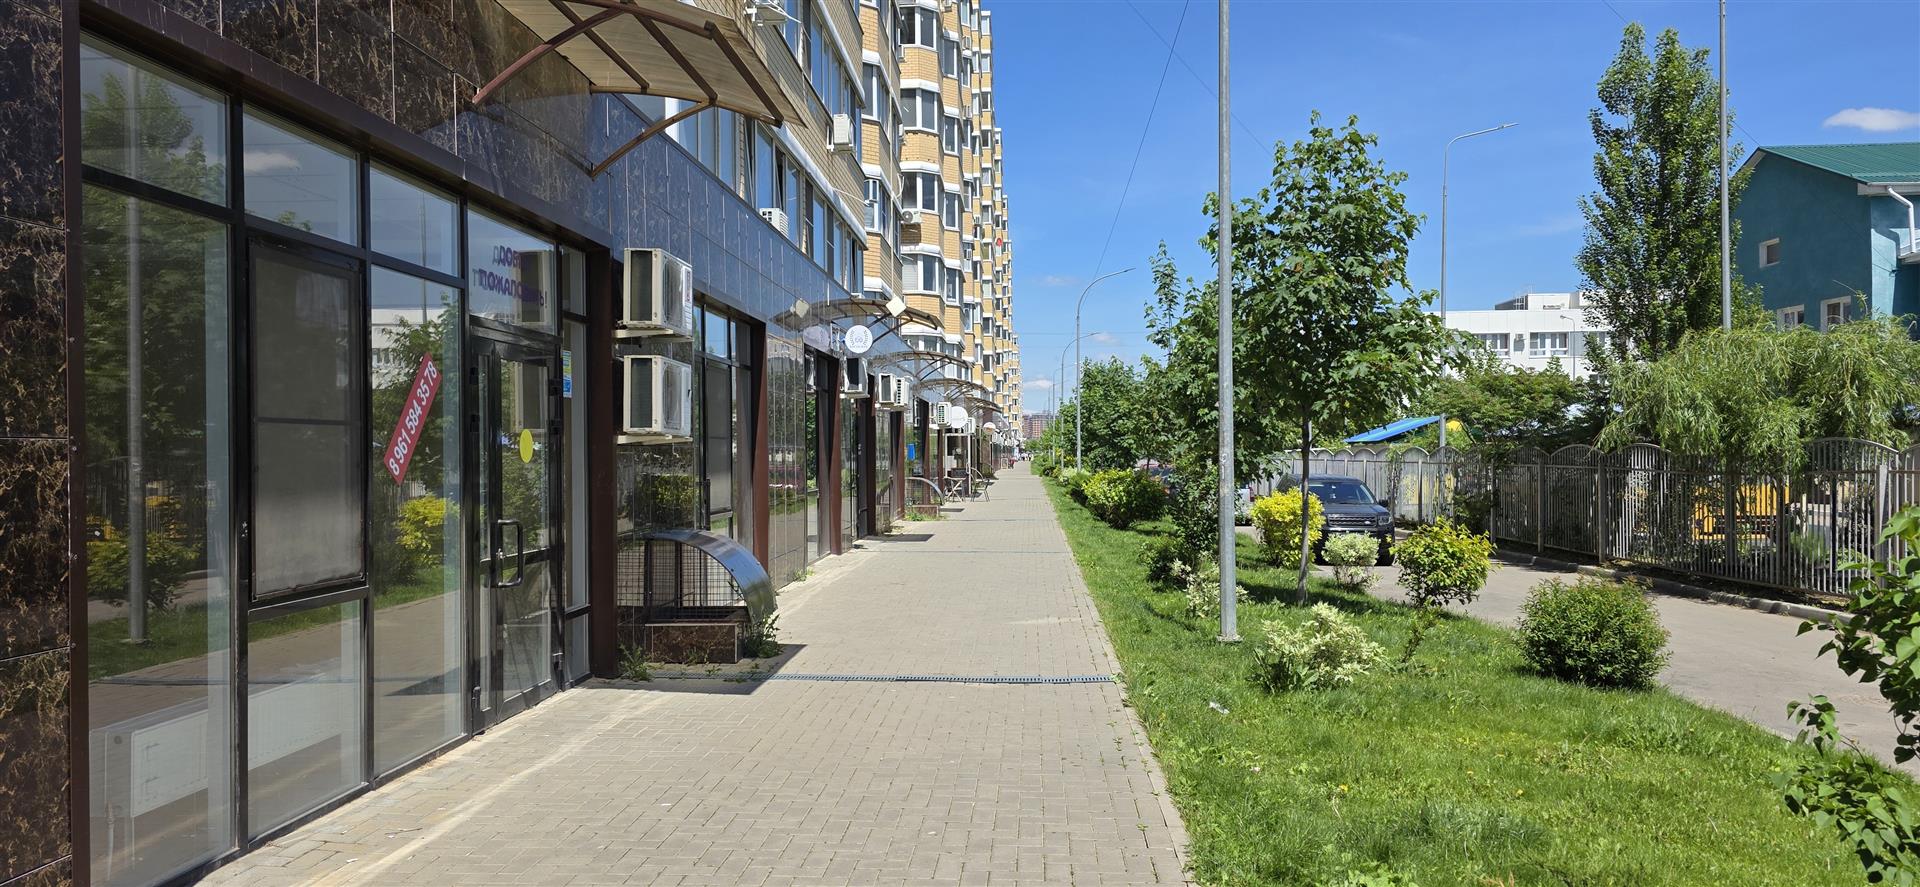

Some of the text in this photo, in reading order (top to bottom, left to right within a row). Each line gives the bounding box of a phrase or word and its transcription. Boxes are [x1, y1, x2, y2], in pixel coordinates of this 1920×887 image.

[389, 361, 437, 476] 8 961 584 35 78
